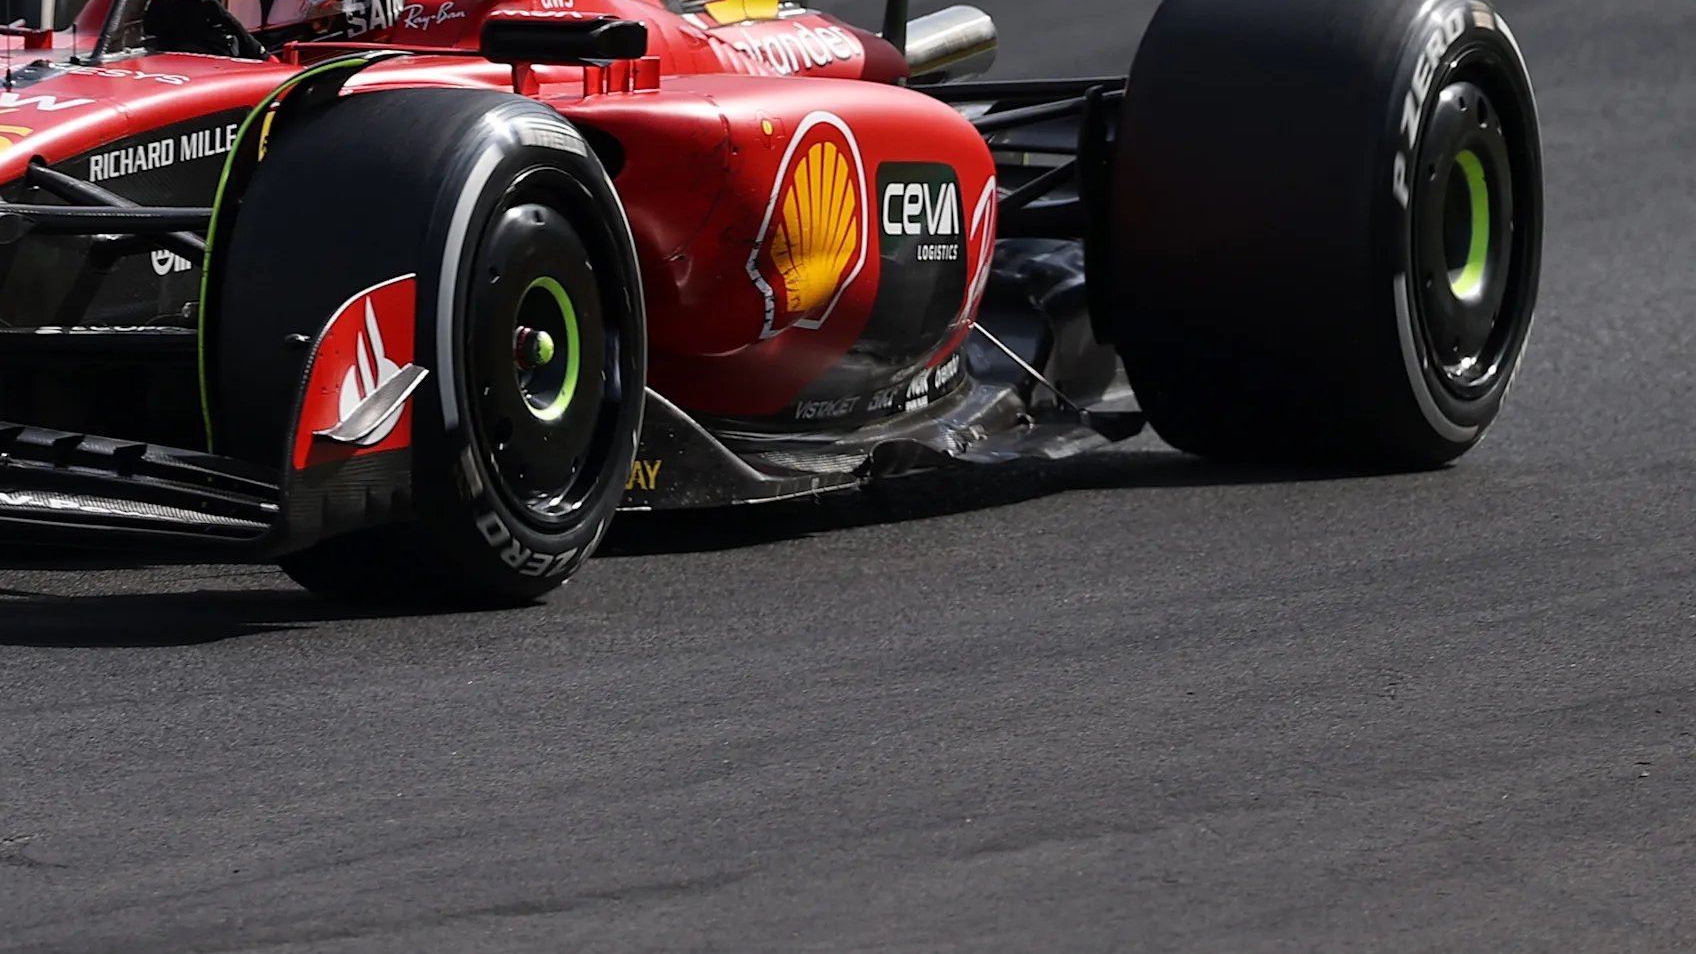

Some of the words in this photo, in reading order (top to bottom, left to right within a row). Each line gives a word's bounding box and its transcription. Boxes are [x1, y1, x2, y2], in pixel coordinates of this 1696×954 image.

[404, 2, 466, 31] Ray-Ban
[1400, 6, 1466, 150] ZERO
[89, 138, 175, 183] RICHARD
[179, 124, 238, 163] MILLE
[917, 244, 959, 261] LOGISTICS
[624, 459, 663, 490] AY
[476, 509, 579, 578] ZERO
